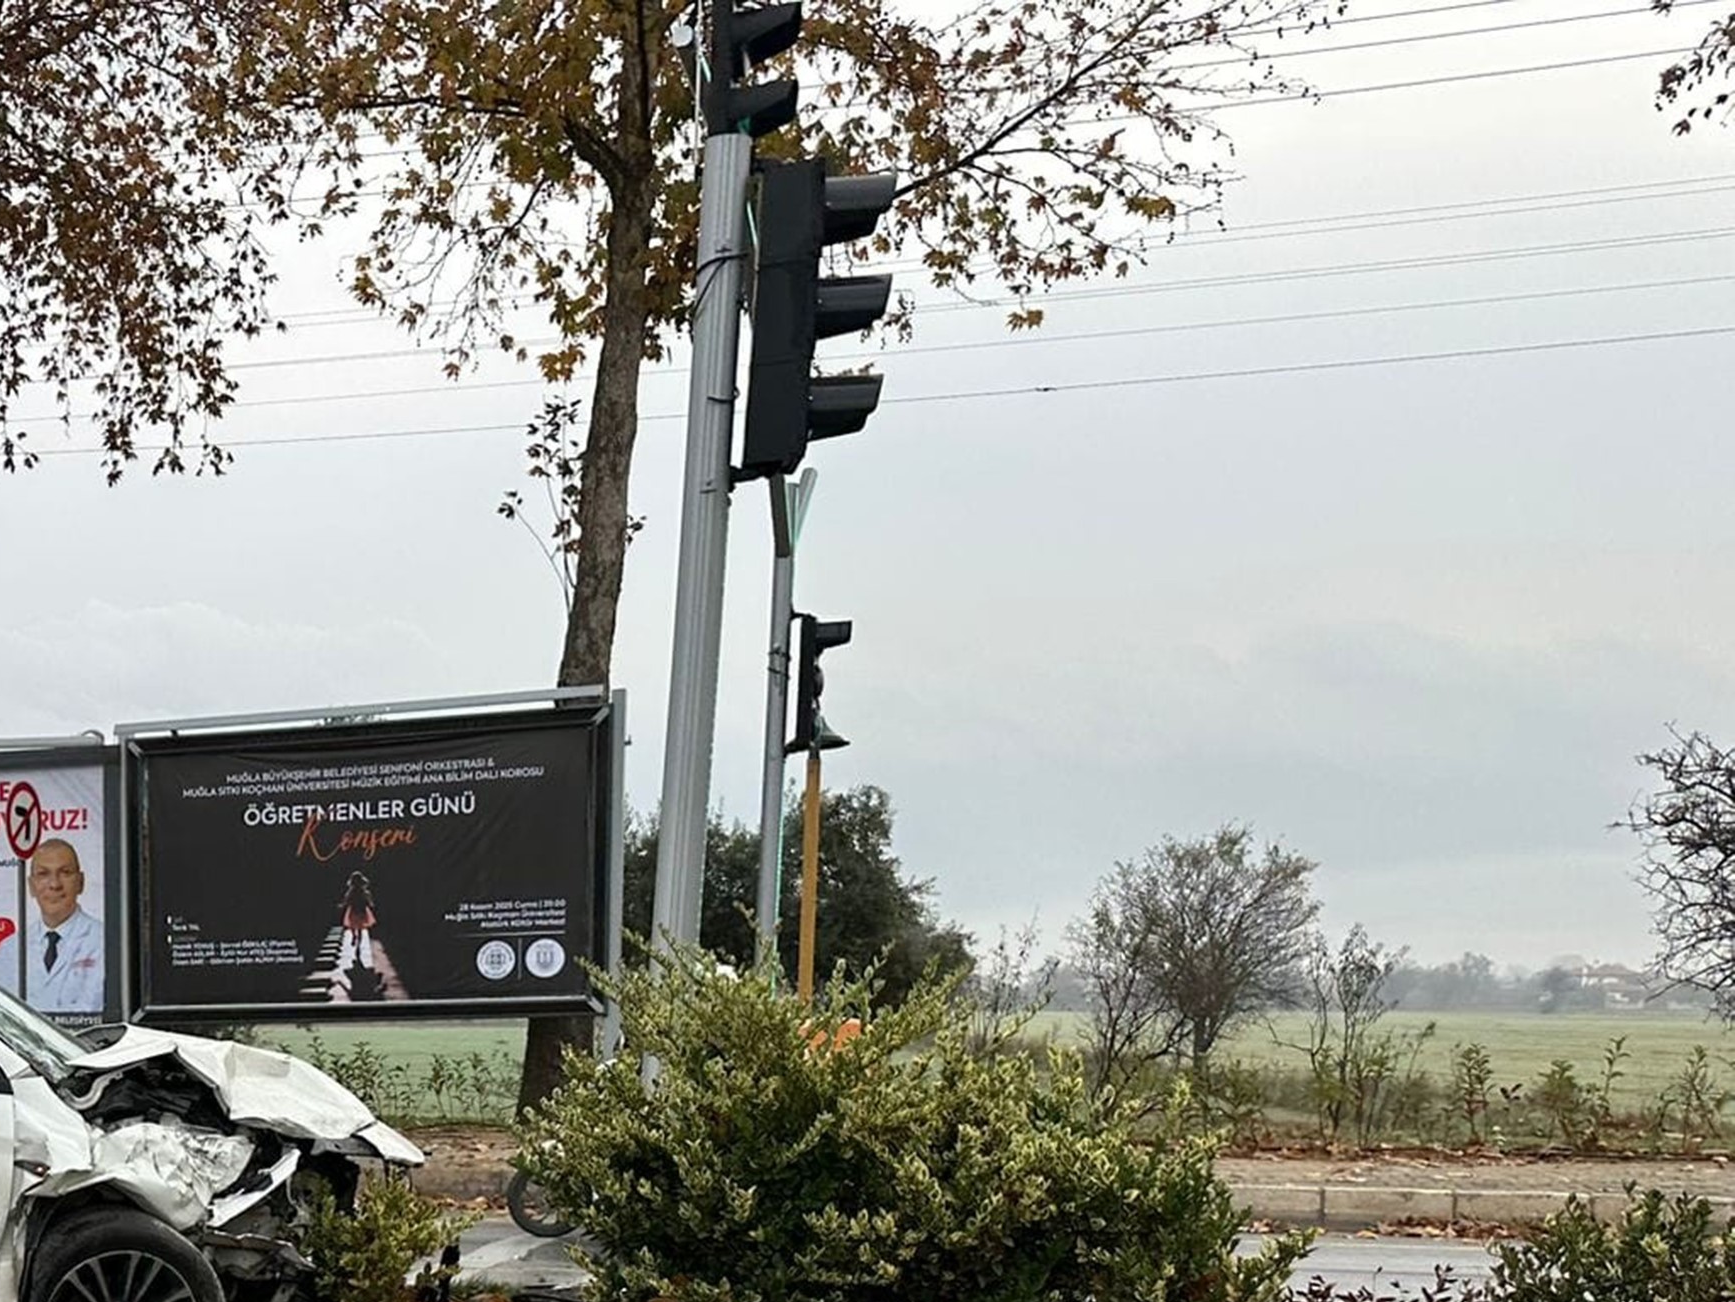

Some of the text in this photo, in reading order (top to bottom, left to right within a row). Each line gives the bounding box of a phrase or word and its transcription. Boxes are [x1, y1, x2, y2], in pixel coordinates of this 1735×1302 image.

[182, 786, 217, 798] MUĞLA
[242, 785, 285, 796] KOÇMAN
[286, 779, 350, 792] ÜNİVERSİTESİ
[352, 776, 383, 788] MÜZİK
[384, 774, 421, 787] EĞİTİMİ
[422, 775, 444, 784] ANA
[445, 772, 473, 782] BİLİM
[475, 770, 499, 780] DALI
[500, 766, 545, 778] KOROSU
[226, 757, 495, 784] MUĞLA BÜYÜKŞEHİR BELEDİYESİ SENFONİ ORKESTRASI &
[243, 790, 476, 826] ÖĞRETMENLER GÜNÜ
